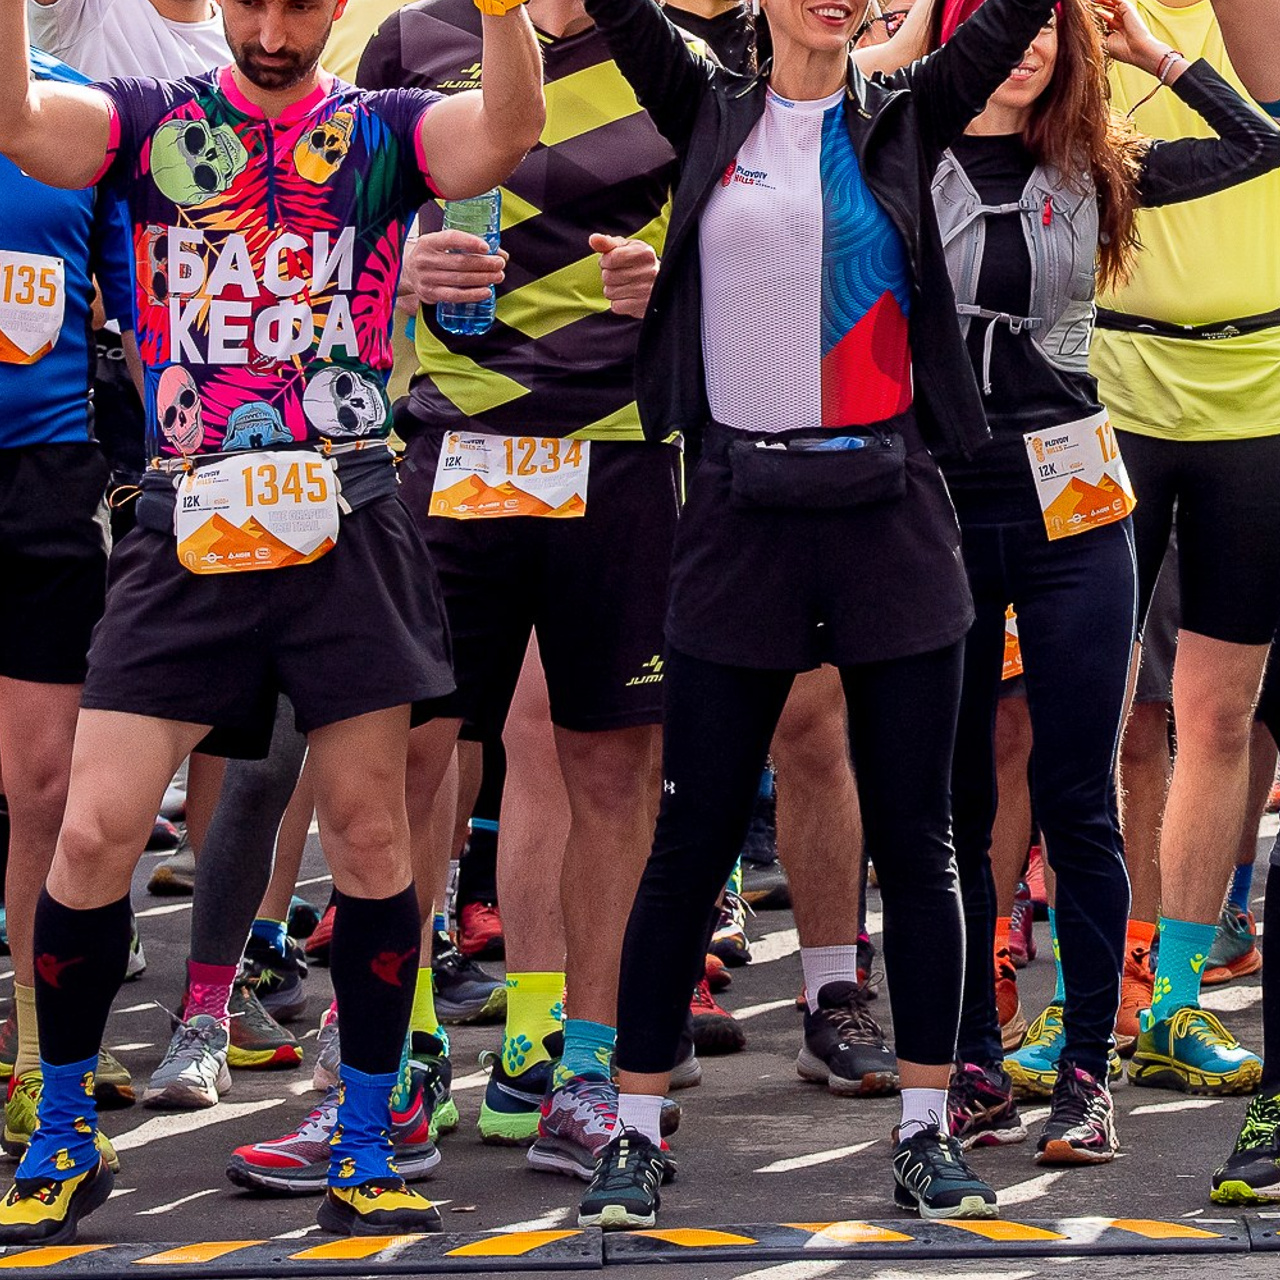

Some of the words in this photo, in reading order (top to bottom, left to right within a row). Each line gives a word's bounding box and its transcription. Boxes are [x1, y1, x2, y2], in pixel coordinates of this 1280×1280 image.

[737, 166, 767, 179] PLOVDIV
[168, 226, 355, 297] БАСИ
[0, 263, 57, 307] 135
[169, 294, 359, 364] КЕФА
[445, 456, 462, 467] 12K
[503, 437, 582, 476] 1234
[1038, 463, 1057, 477] 12K
[182, 495, 201, 509] 12K
[242, 463, 327, 506] 1345
